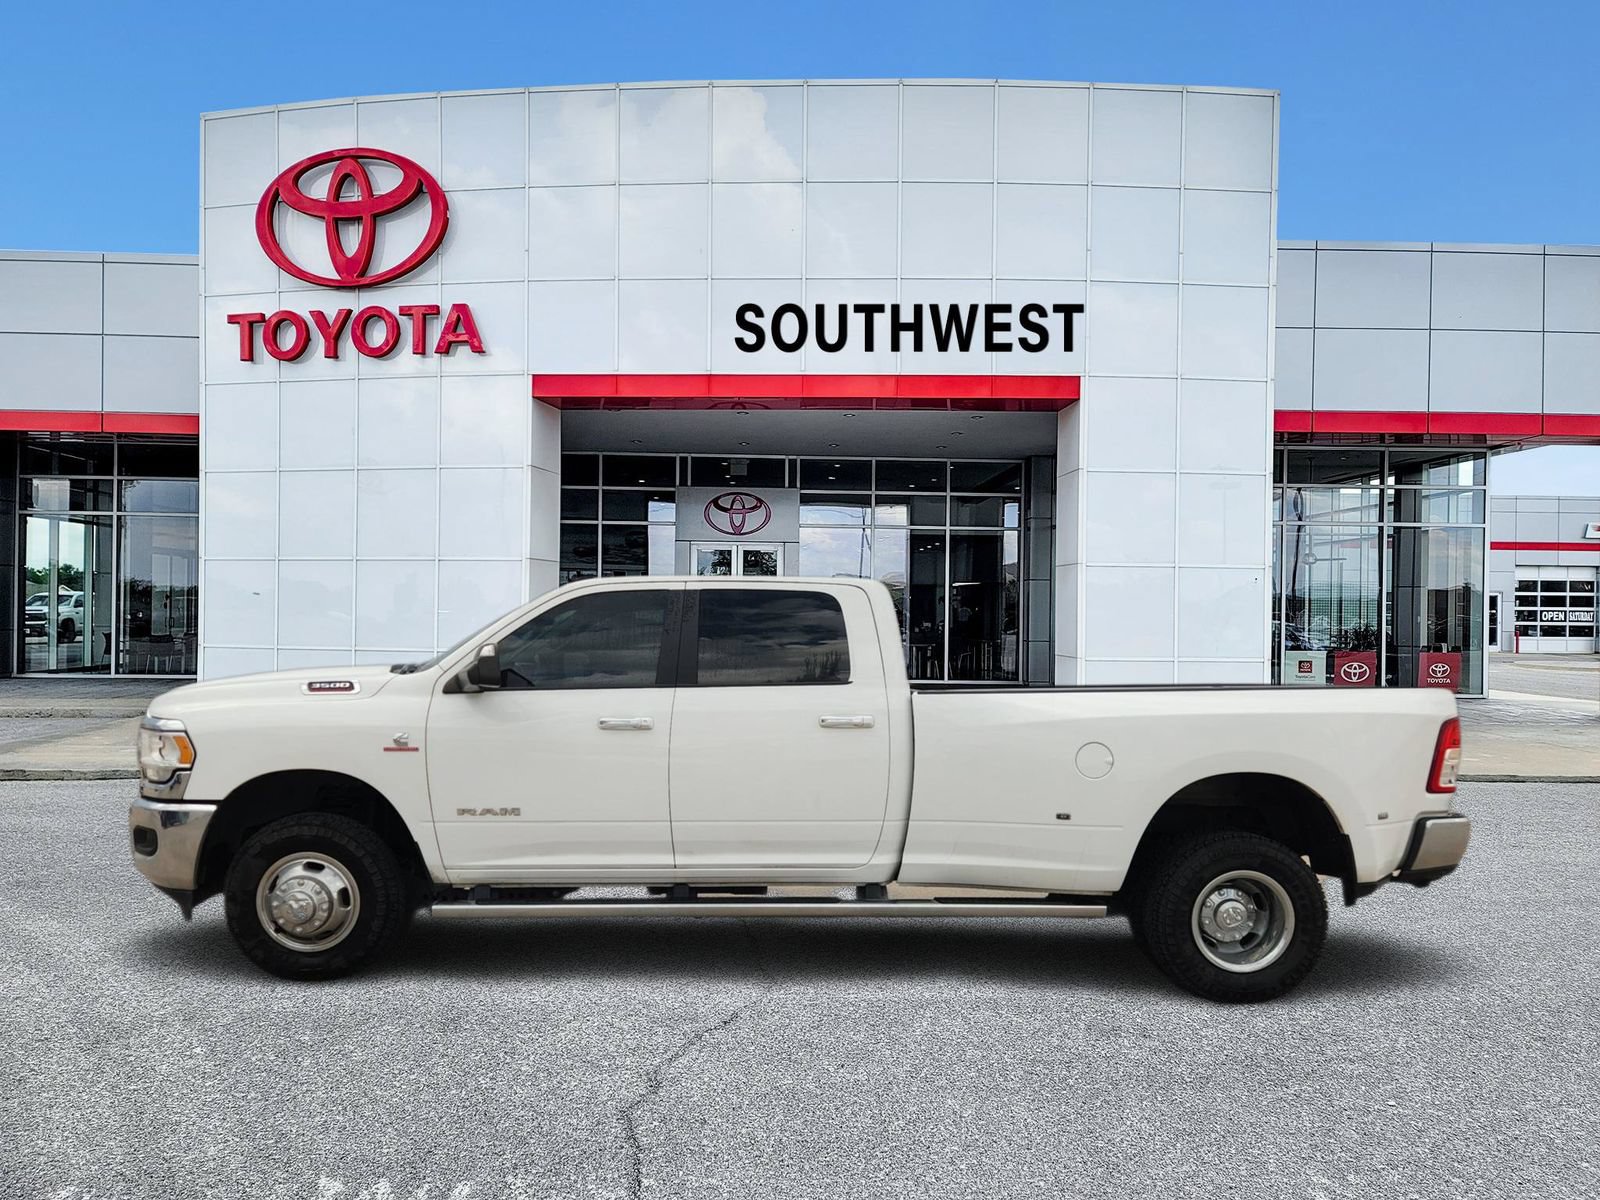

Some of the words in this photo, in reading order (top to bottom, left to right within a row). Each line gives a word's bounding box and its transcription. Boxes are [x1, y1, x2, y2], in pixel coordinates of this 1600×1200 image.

[227, 303, 486, 362] TOYOTA
[735, 303, 1084, 352] SOUTHWEST
[1542, 611, 1565, 621] OPEN
[1569, 612, 1593, 621] SATURDAY
[456, 807, 521, 816] RAM
